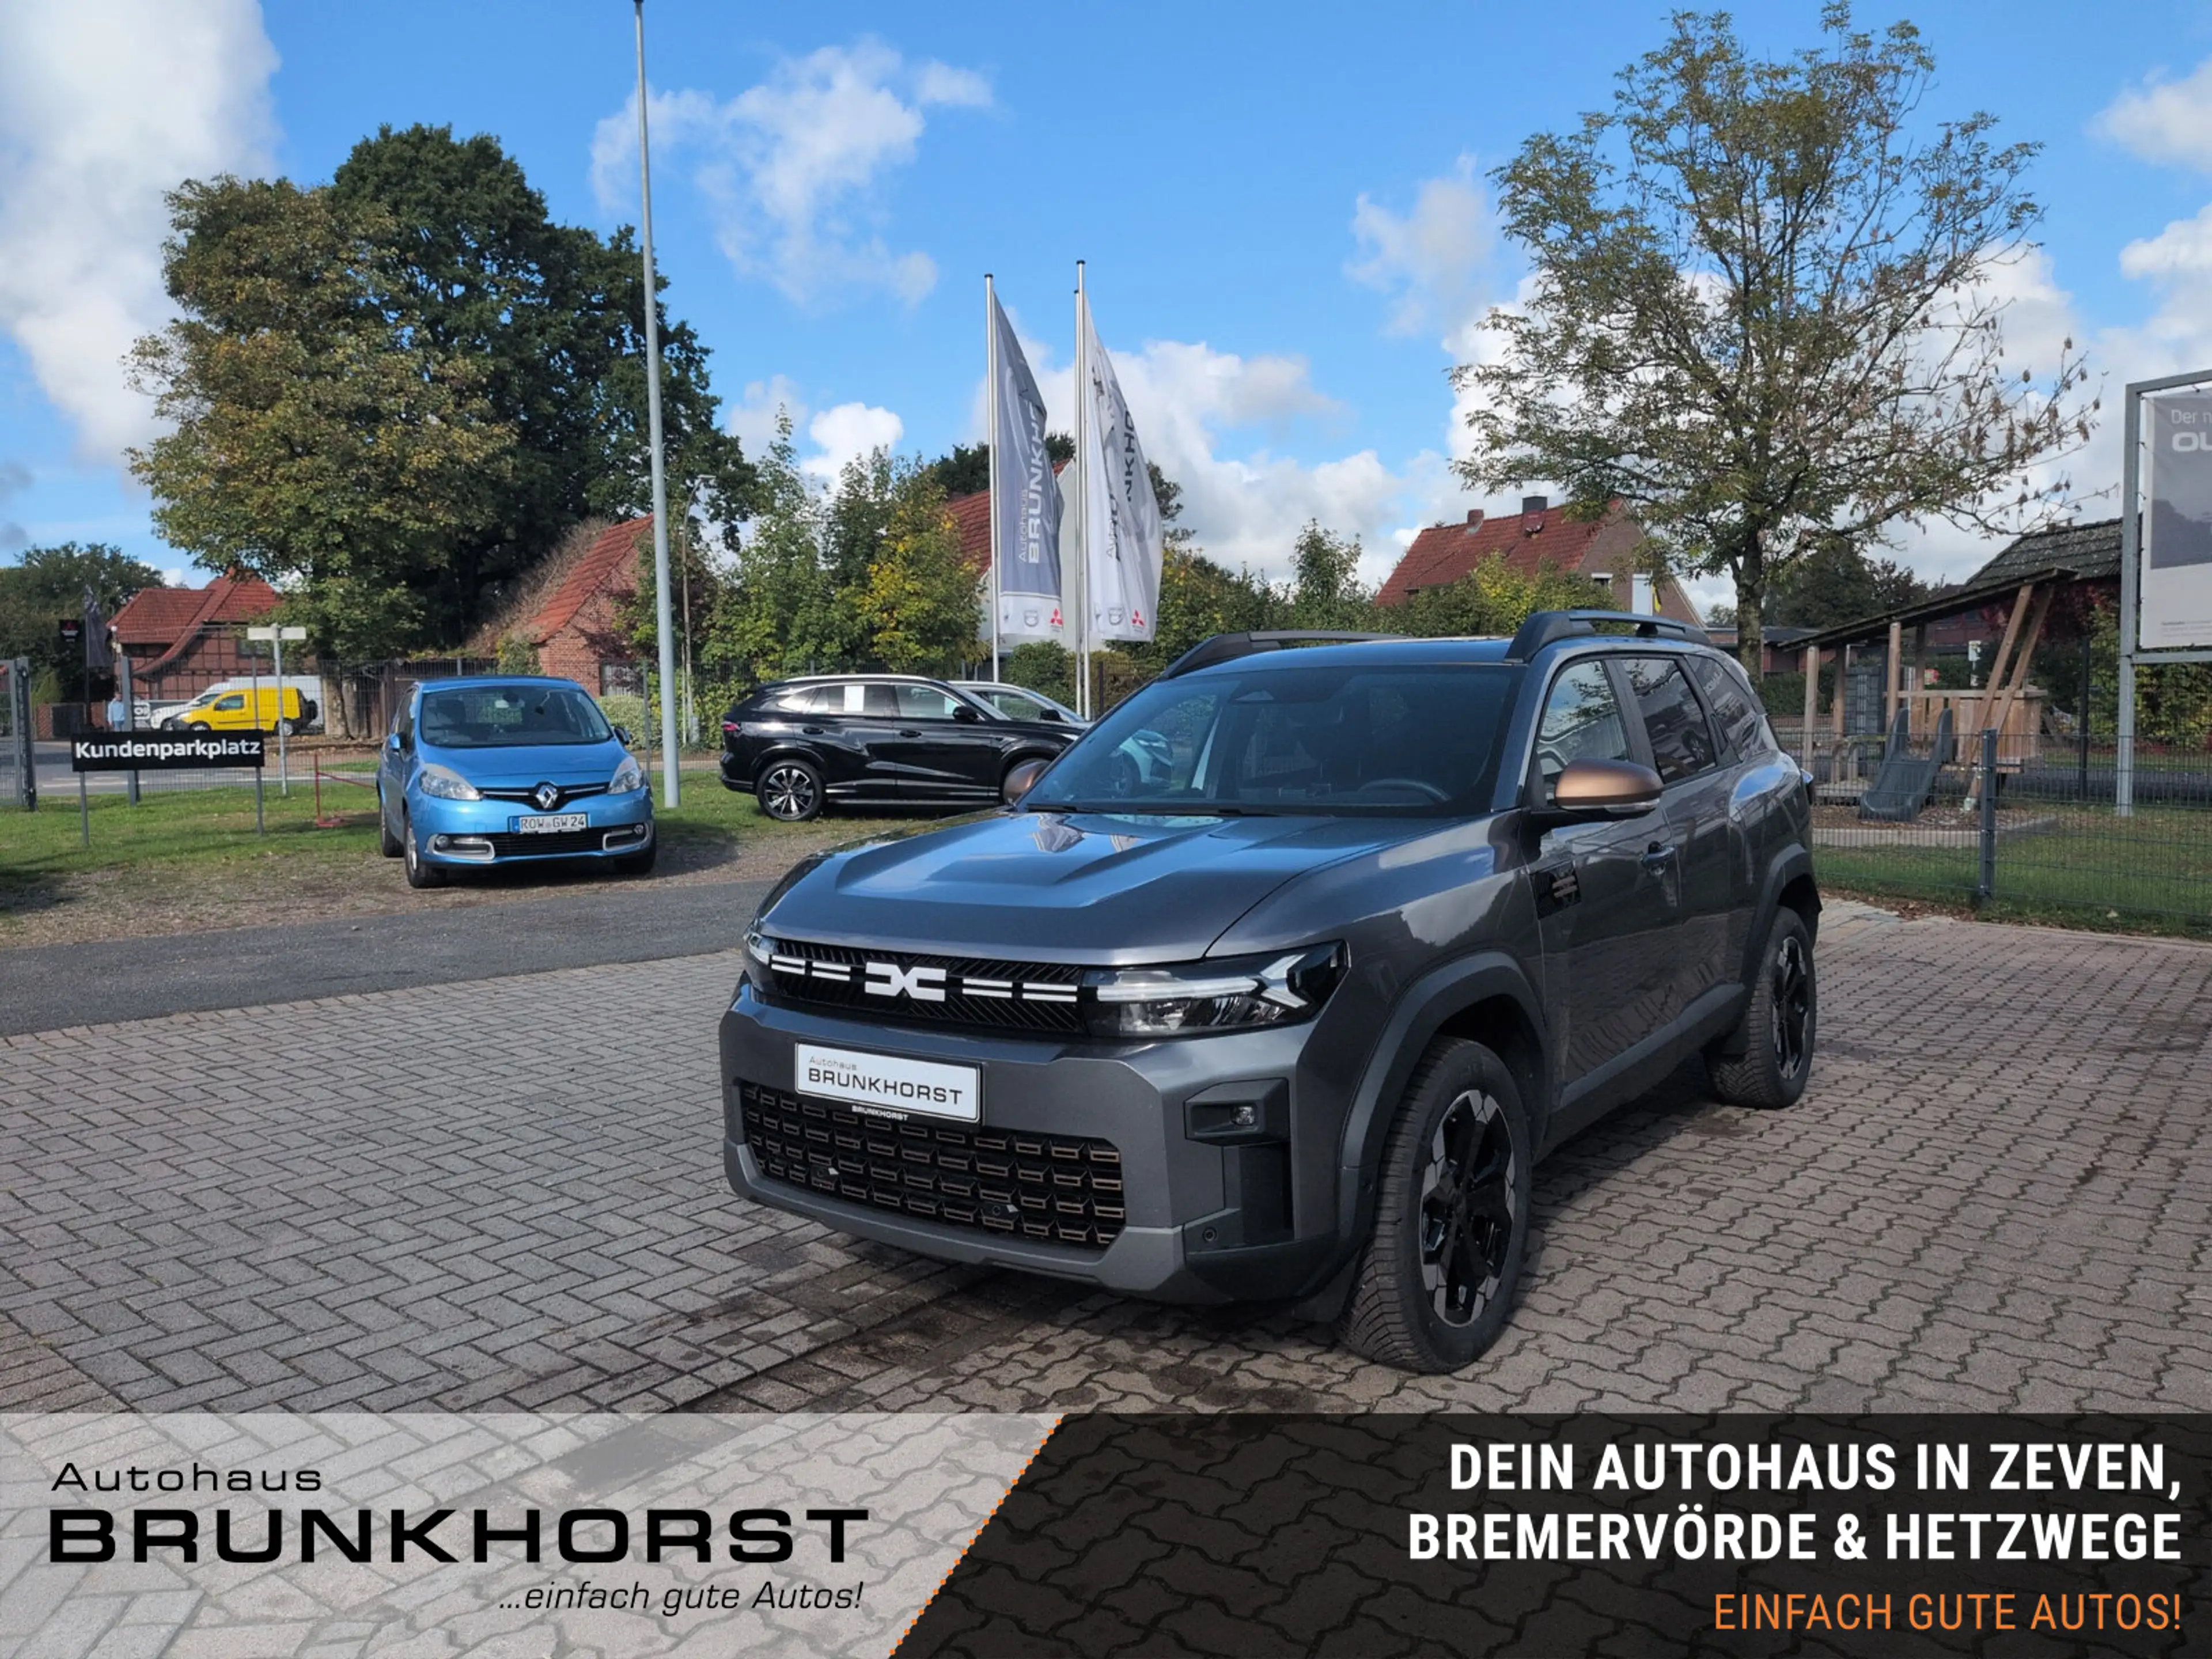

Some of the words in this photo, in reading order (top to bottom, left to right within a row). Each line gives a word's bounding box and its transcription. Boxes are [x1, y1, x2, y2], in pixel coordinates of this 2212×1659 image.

[2171, 409, 2198, 424] Der
[75, 739, 260, 760] Kundenparkplatz
[521, 818, 544, 829] ROW
[552, 816, 567, 828] GW
[571, 815, 585, 826] 24
[809, 1056, 857, 1071] Autohaus
[808, 1068, 963, 1105] BRUNKHORST
[851, 1105, 909, 1121] BRUNKHORST
